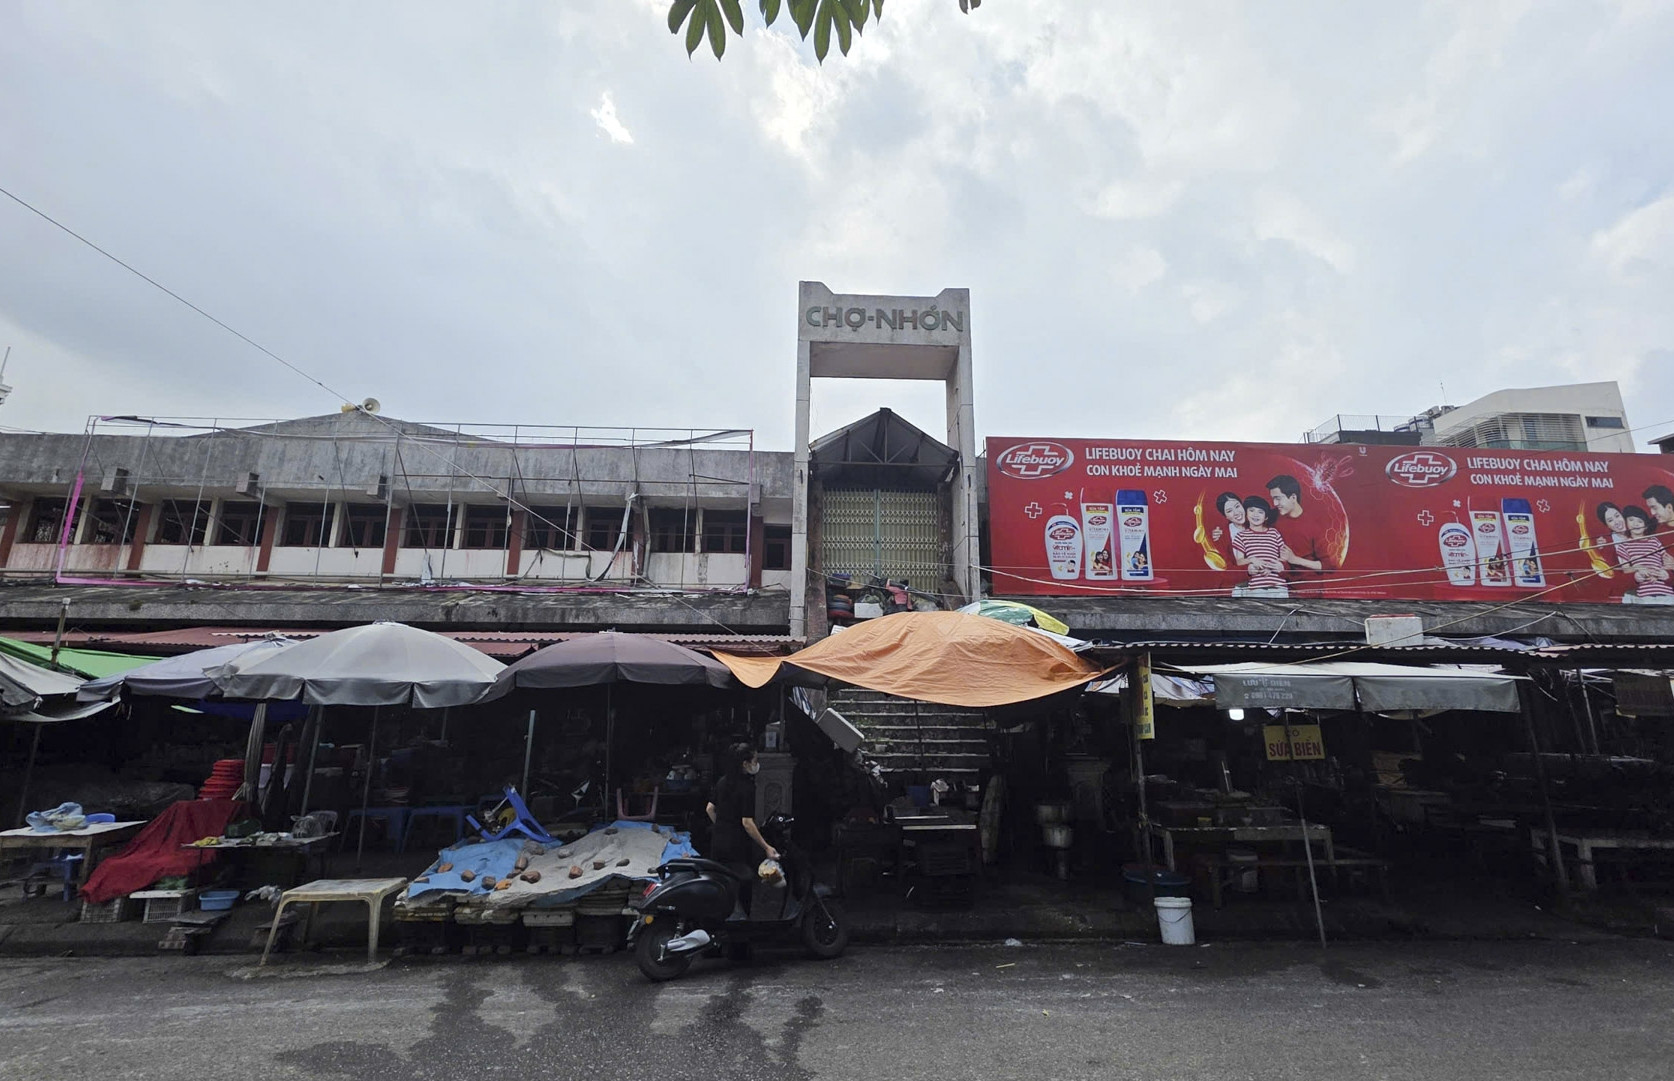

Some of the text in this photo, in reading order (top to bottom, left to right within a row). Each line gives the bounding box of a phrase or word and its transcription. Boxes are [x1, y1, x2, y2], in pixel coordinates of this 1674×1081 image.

[1006, 453, 1064, 465] Lifebuoy
[1086, 447, 1235, 461] LIFEBUOY CHAI HÔM NAY
[1086, 465, 1109, 476] CON
[1144, 466, 1180, 479] MẠNH
[1182, 465, 1212, 478] NGÀY
[1215, 468, 1238, 478] MAI
[1393, 463, 1449, 475] Lifebuoy
[1467, 457, 1609, 473] LIFEBUOY CHAI HÔM NAY
[1470, 474, 1494, 486] CON
[1524, 476, 1559, 489] MẠNH
[1561, 474, 1590, 488] NGÀY
[1591, 477, 1614, 488] MAI
